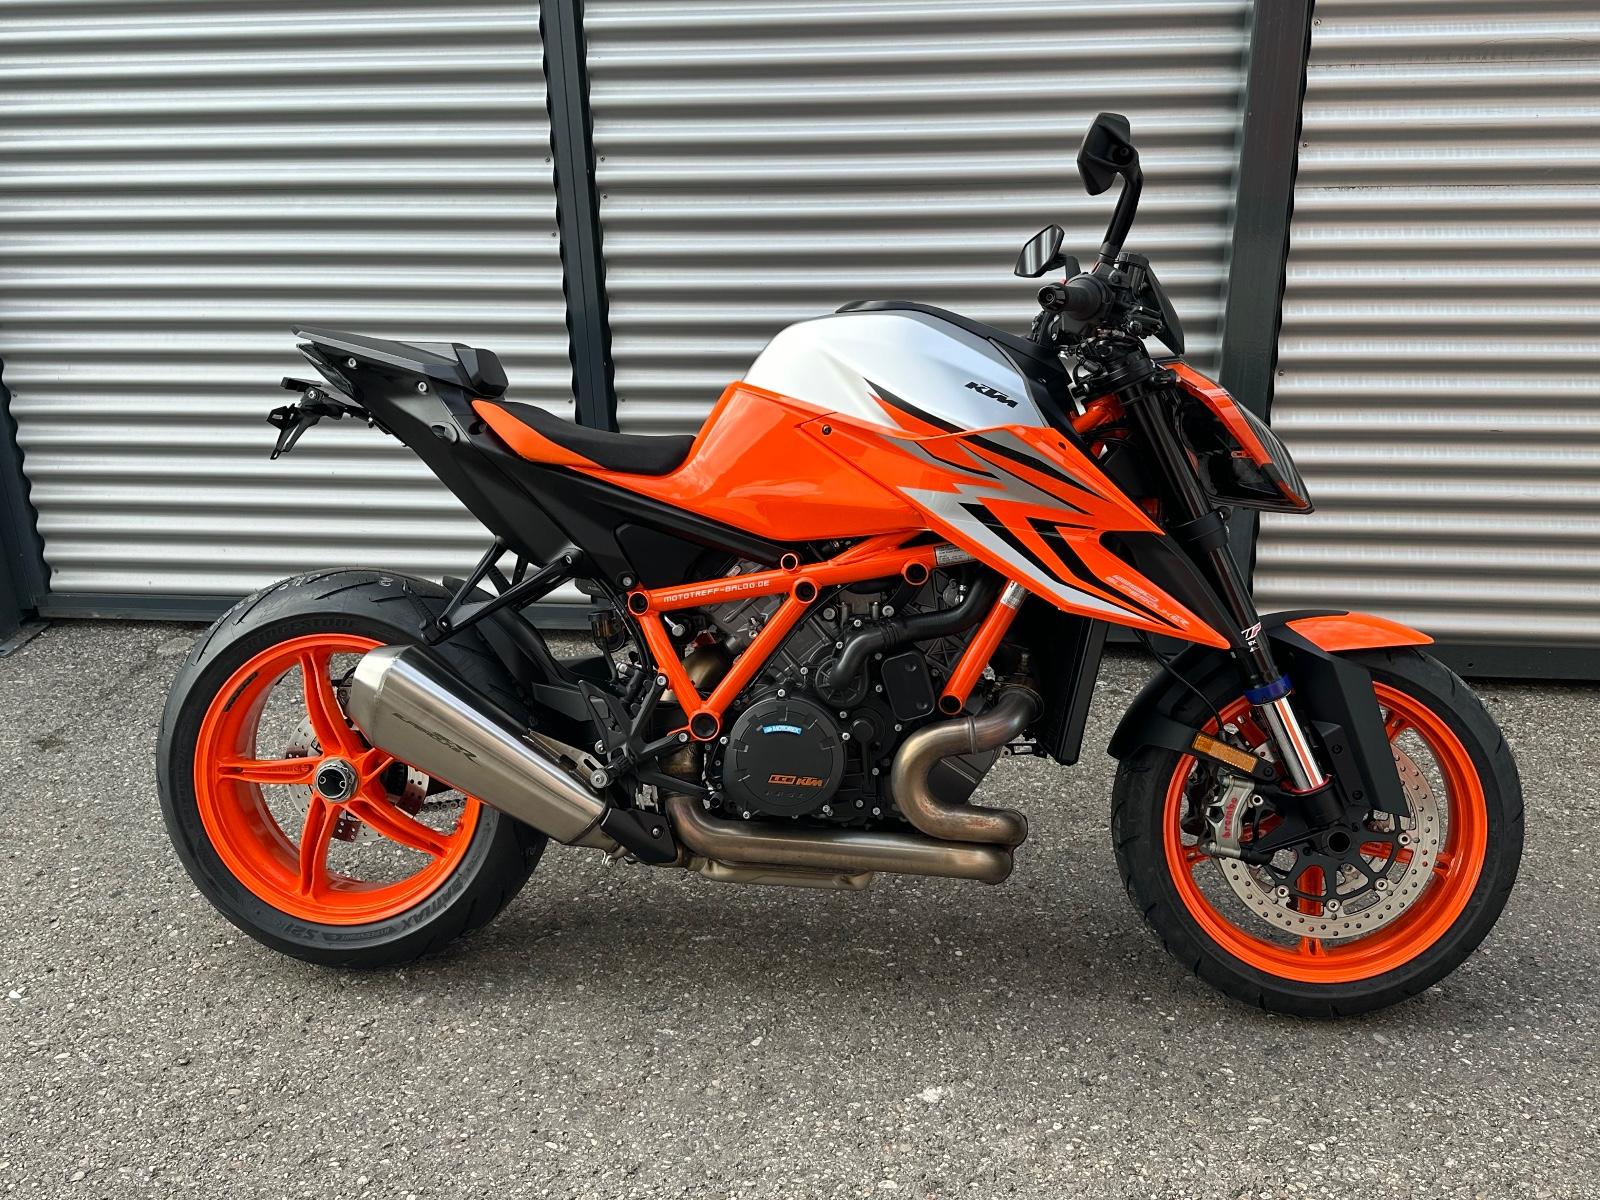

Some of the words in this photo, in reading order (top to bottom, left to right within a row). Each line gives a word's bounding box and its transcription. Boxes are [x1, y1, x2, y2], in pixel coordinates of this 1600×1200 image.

[964, 381, 1019, 409] KTM
[796, 776, 824, 788] KTM
[1222, 797, 1238, 840] brembo
